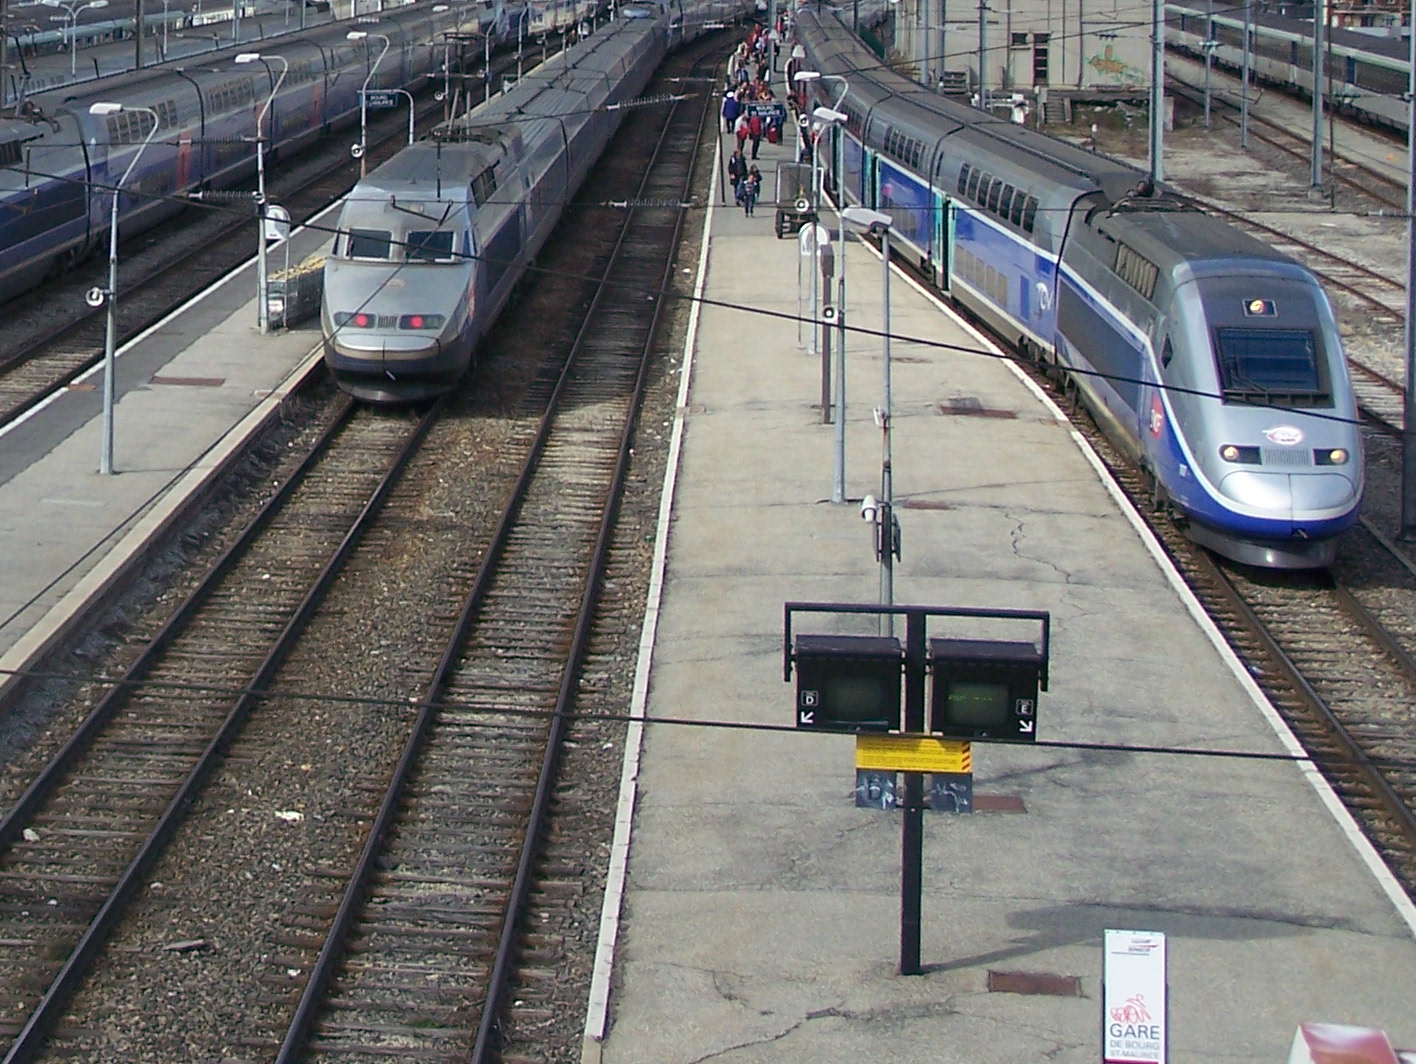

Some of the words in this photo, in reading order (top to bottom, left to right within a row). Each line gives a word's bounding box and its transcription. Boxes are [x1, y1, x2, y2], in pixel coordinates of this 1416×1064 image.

[805, 696, 815, 705] D
[1021, 704, 1028, 713] E
[1110, 1023, 1160, 1040] GARE
[1110, 1039, 1122, 1048] DE
[1125, 1040, 1160, 1050] BOURG
